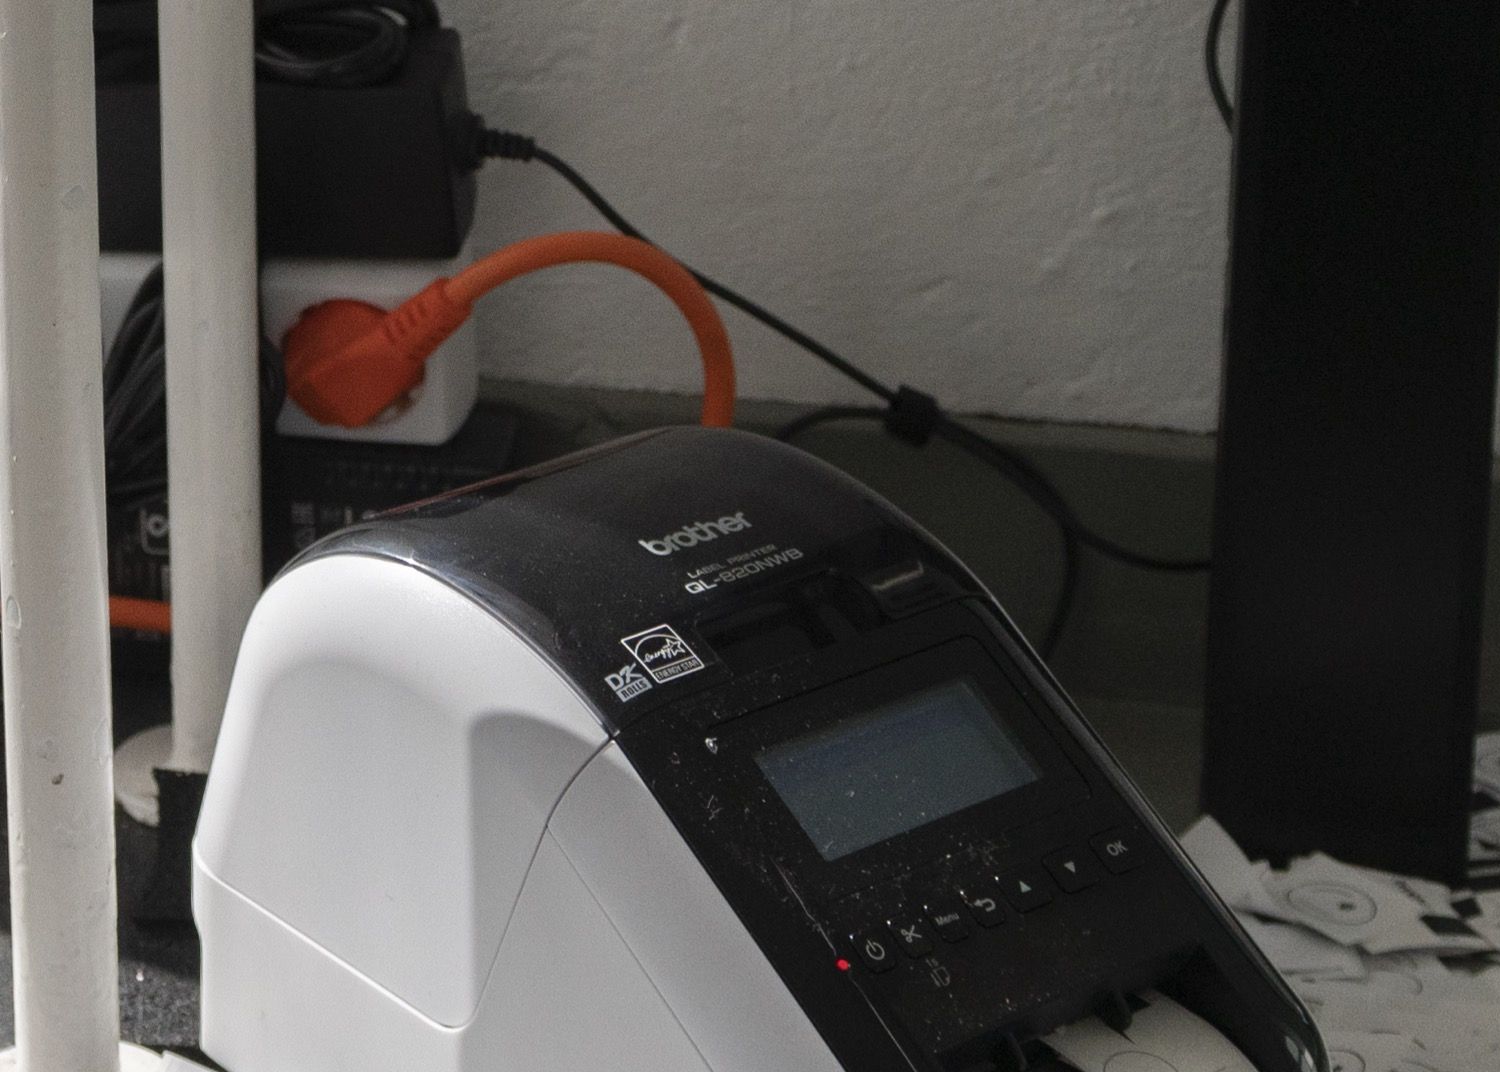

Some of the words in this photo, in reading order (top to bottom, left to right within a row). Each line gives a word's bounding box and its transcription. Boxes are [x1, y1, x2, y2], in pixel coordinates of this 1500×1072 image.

[638, 512, 752, 556] brother
[684, 547, 804, 594] QL-820NWB
[687, 562, 727, 579] LABEL
[726, 543, 778, 567] PRINTER
[604, 662, 643, 692] DK
[655, 665, 682, 680] ENERGY
[680, 659, 701, 673] STAR
[620, 679, 648, 699] ROLLS
[1106, 840, 1129, 857] OK
[934, 912, 960, 926] Menu
